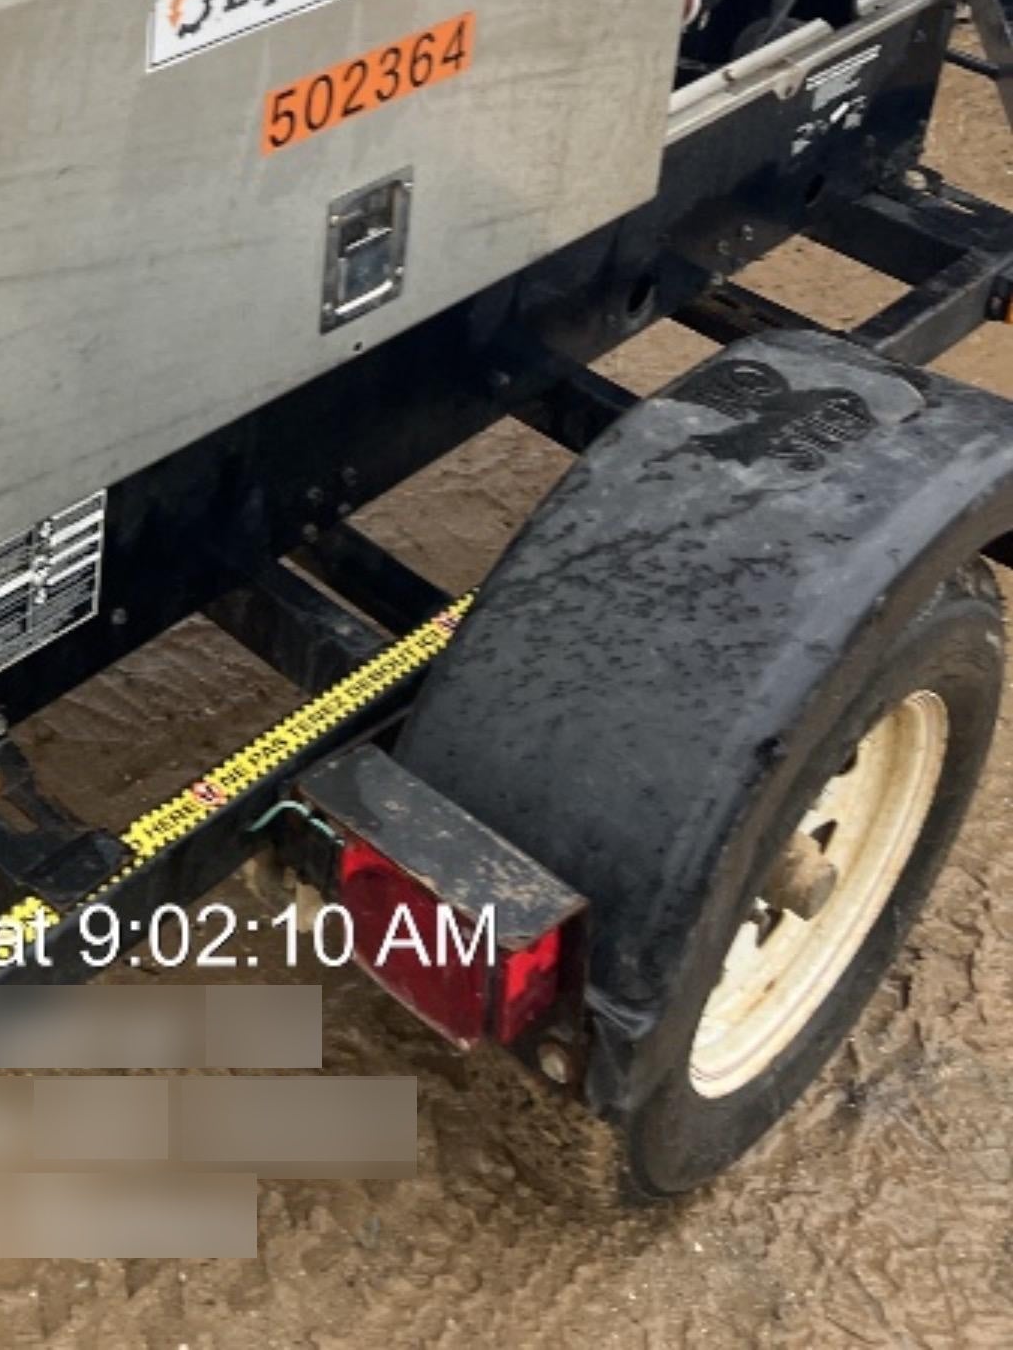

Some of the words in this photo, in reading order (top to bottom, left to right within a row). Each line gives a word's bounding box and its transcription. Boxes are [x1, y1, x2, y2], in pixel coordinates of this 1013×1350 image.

[269, 19, 468, 148] 502364
[247, 737, 290, 766] PAS
[344, 643, 420, 699] DEBOUT
